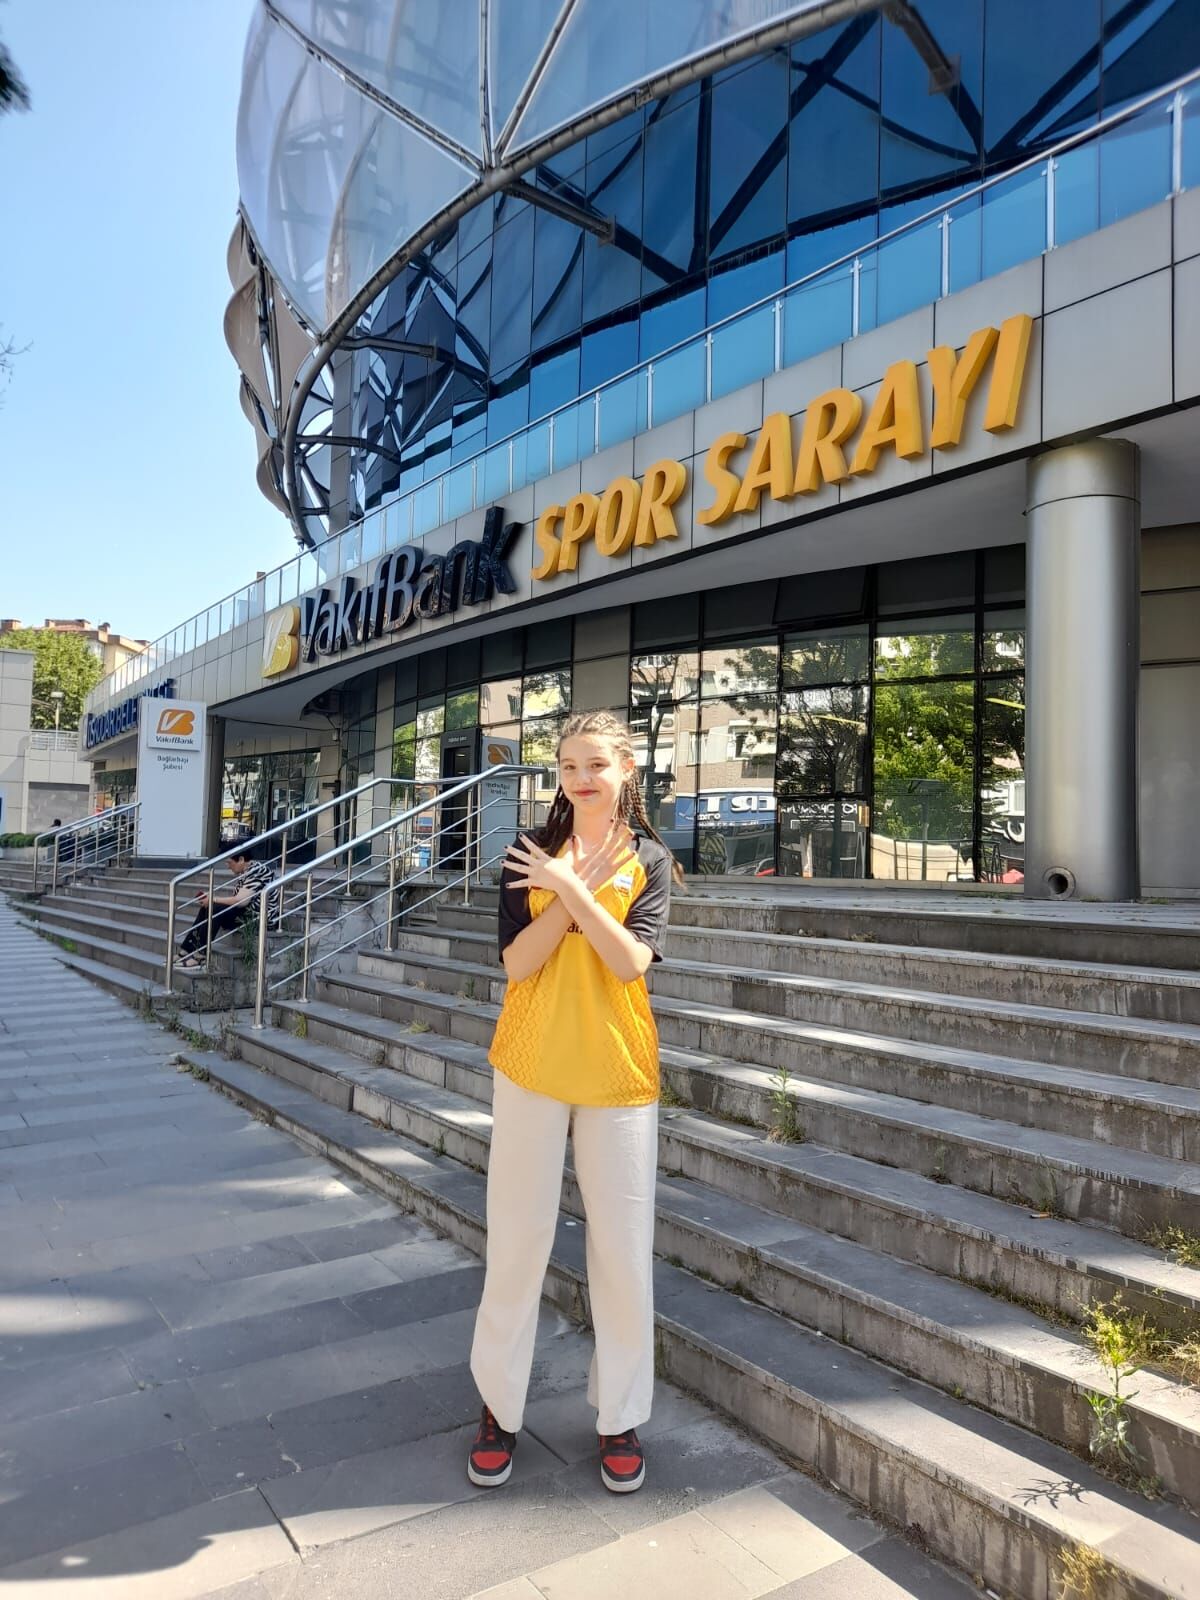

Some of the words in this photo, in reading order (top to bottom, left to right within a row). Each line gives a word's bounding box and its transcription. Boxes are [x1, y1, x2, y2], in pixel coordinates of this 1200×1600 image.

[301, 505, 524, 664] VakıfBank
[531, 458, 688, 582] SPOR
[696, 313, 1033, 527] SARAYI
[155, 735, 194, 745] VakıfBank
